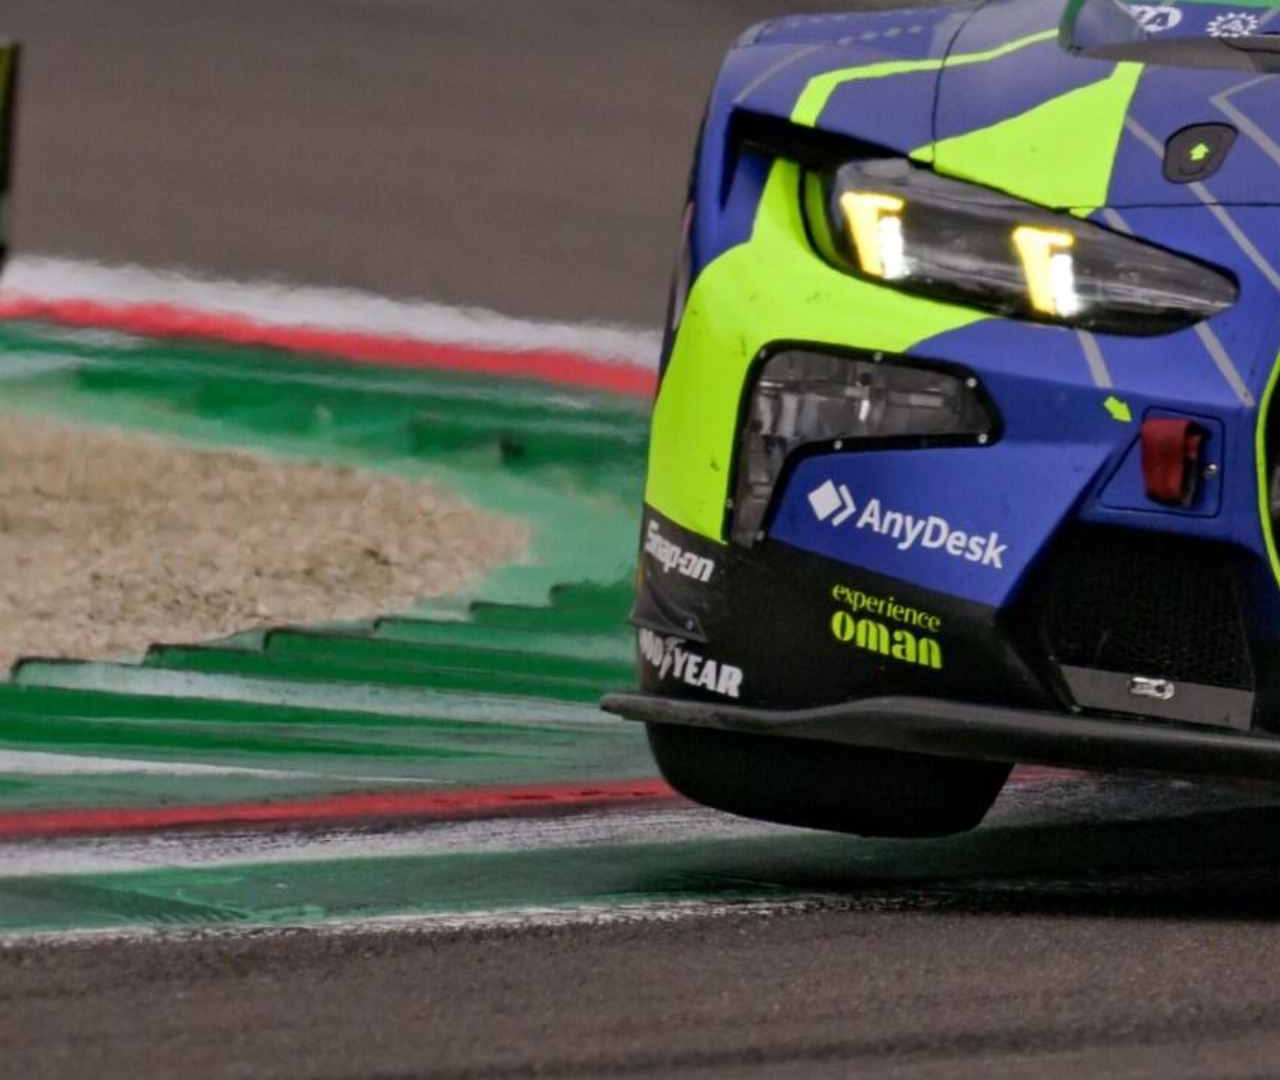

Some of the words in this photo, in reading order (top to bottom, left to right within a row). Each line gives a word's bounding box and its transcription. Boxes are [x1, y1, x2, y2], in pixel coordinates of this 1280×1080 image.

[856, 498, 1008, 569] AnyDesk
[832, 583, 941, 633] experience
[830, 610, 942, 669] oman
